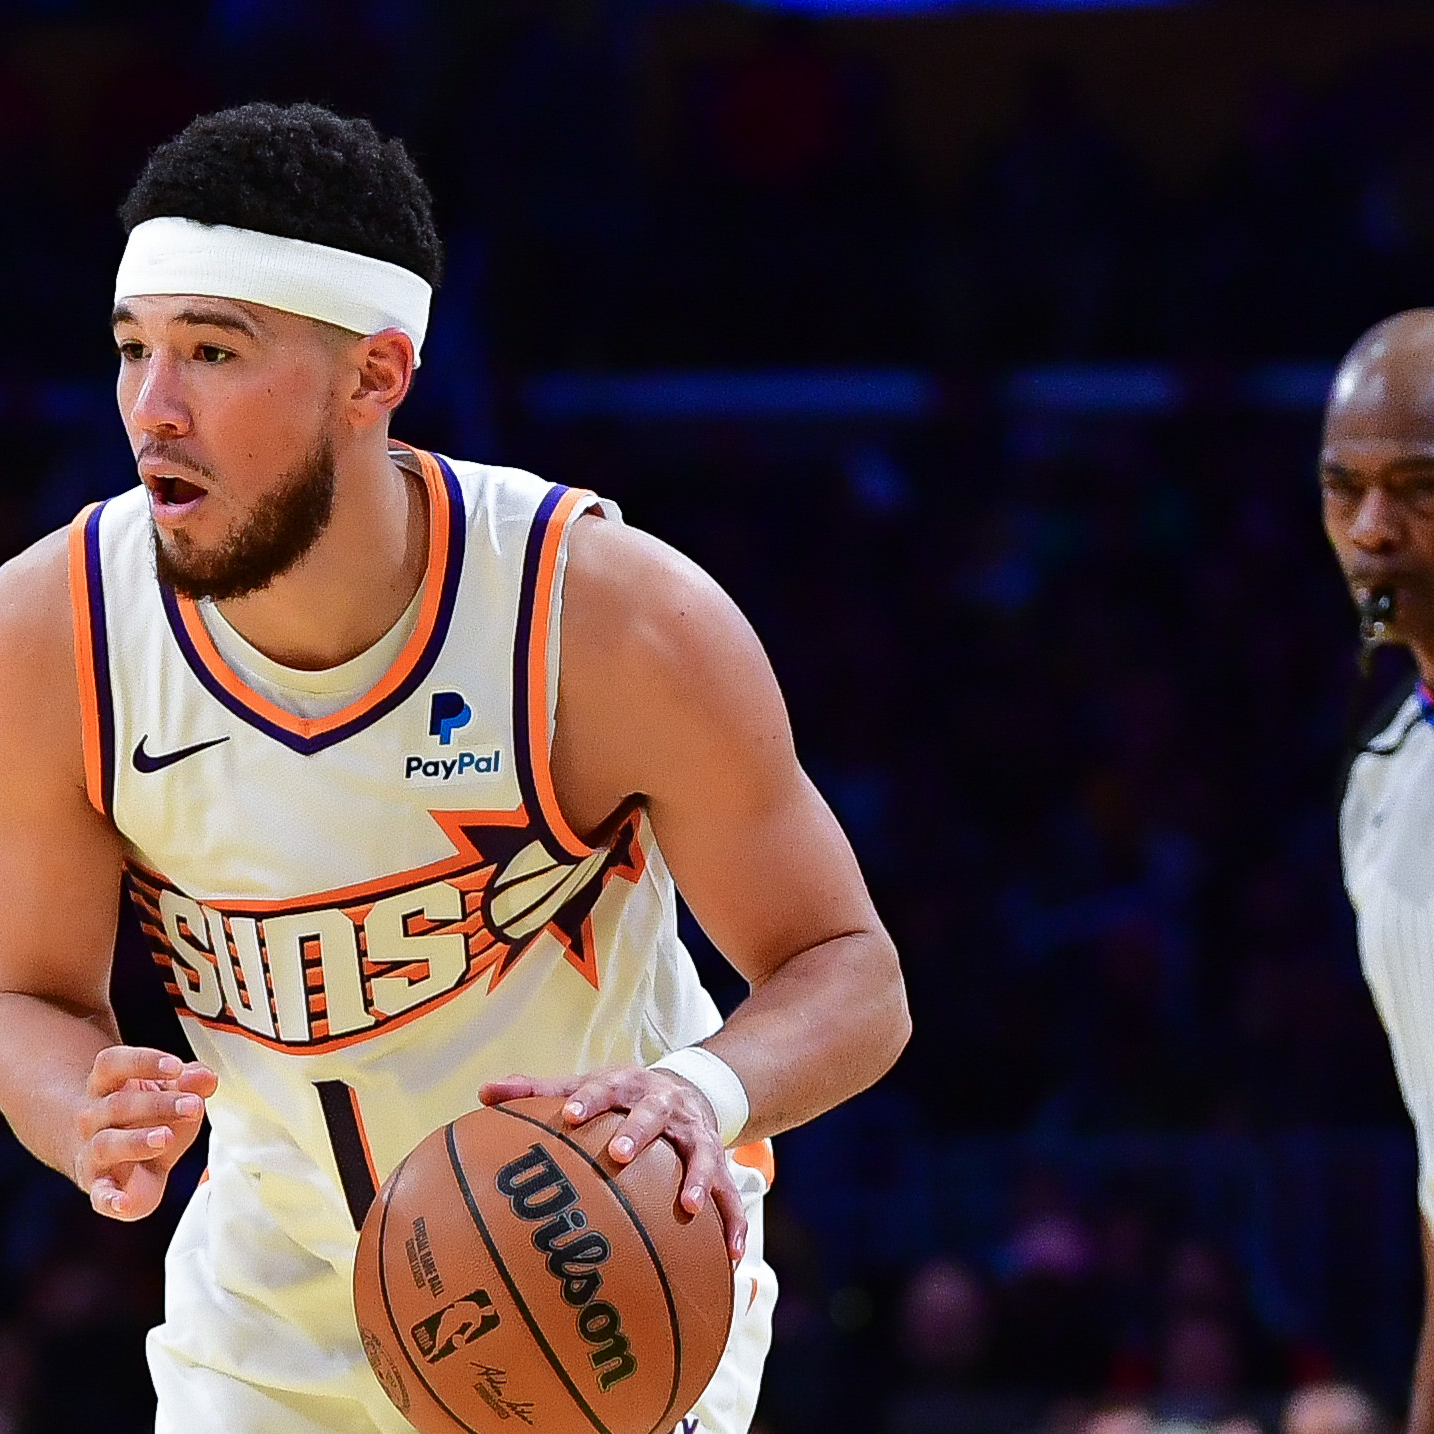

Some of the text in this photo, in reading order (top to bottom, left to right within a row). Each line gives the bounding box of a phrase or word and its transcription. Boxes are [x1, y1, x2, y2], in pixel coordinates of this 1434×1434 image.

[404, 749, 501, 781] PayPal
[311, 1079, 382, 1233] 1
[495, 1143, 638, 1393] Wilson
[428, 1273, 445, 1299] BALL
[414, 1326, 434, 1350] NBA
